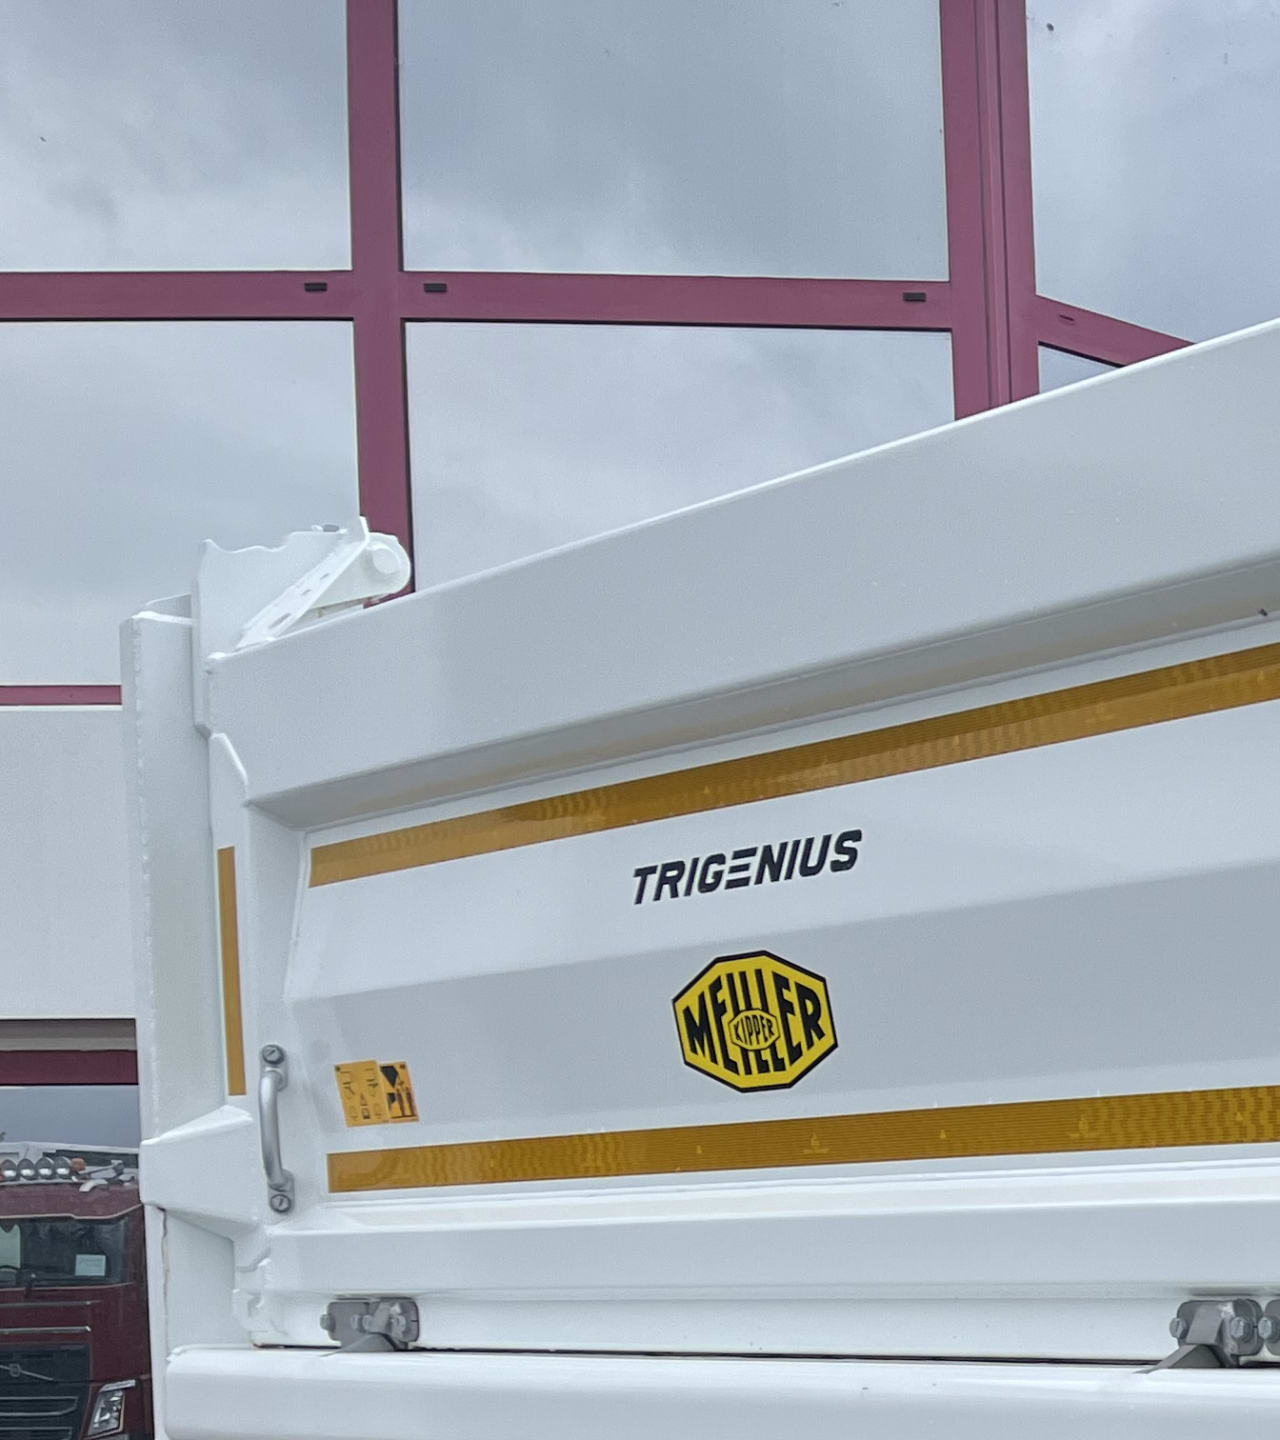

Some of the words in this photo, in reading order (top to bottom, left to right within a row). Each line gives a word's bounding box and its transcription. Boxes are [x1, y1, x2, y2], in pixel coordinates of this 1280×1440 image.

[633, 829, 863, 906] TRIGENIUS
[683, 968, 826, 1075] MEILLER
[733, 1014, 775, 1046] KIPPER
